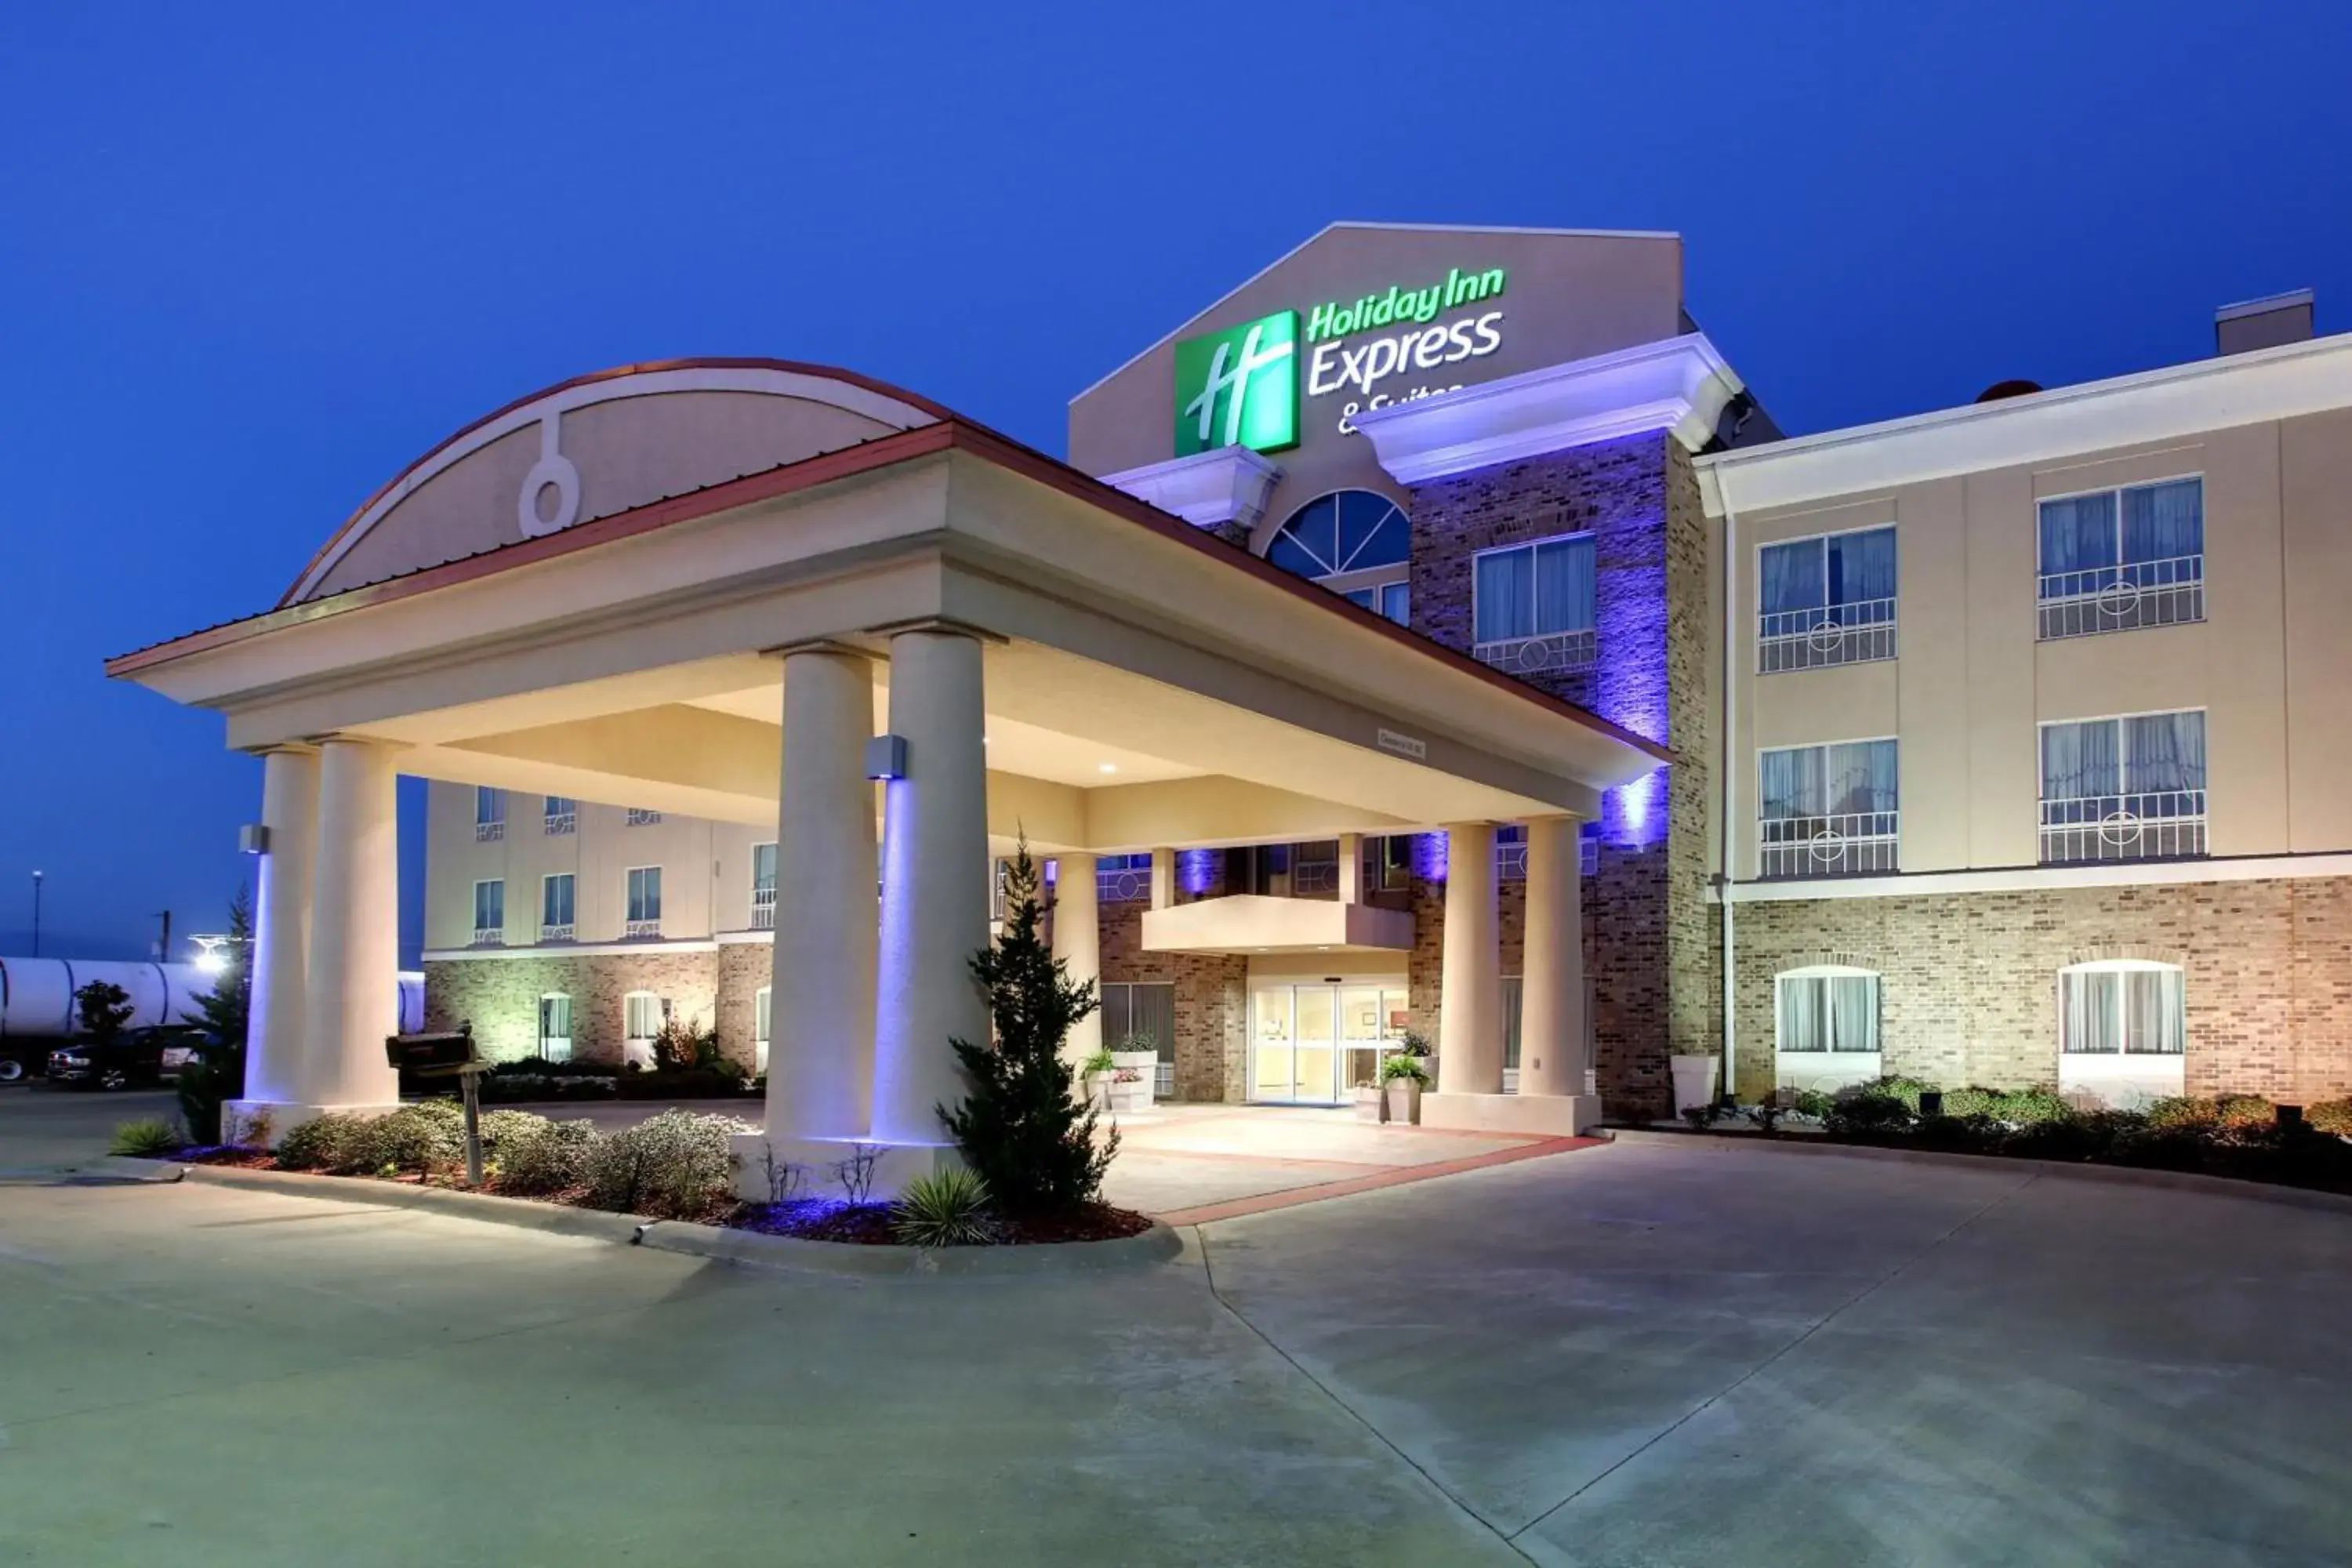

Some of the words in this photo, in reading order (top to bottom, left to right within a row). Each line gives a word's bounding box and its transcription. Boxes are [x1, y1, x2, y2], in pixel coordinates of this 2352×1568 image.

[1306, 285, 1439, 342] Holiday
[1444, 267, 1504, 307] Inn
[1185, 325, 1293, 445] H
[1308, 311, 1503, 396] Express
[1338, 401, 1359, 434] &
